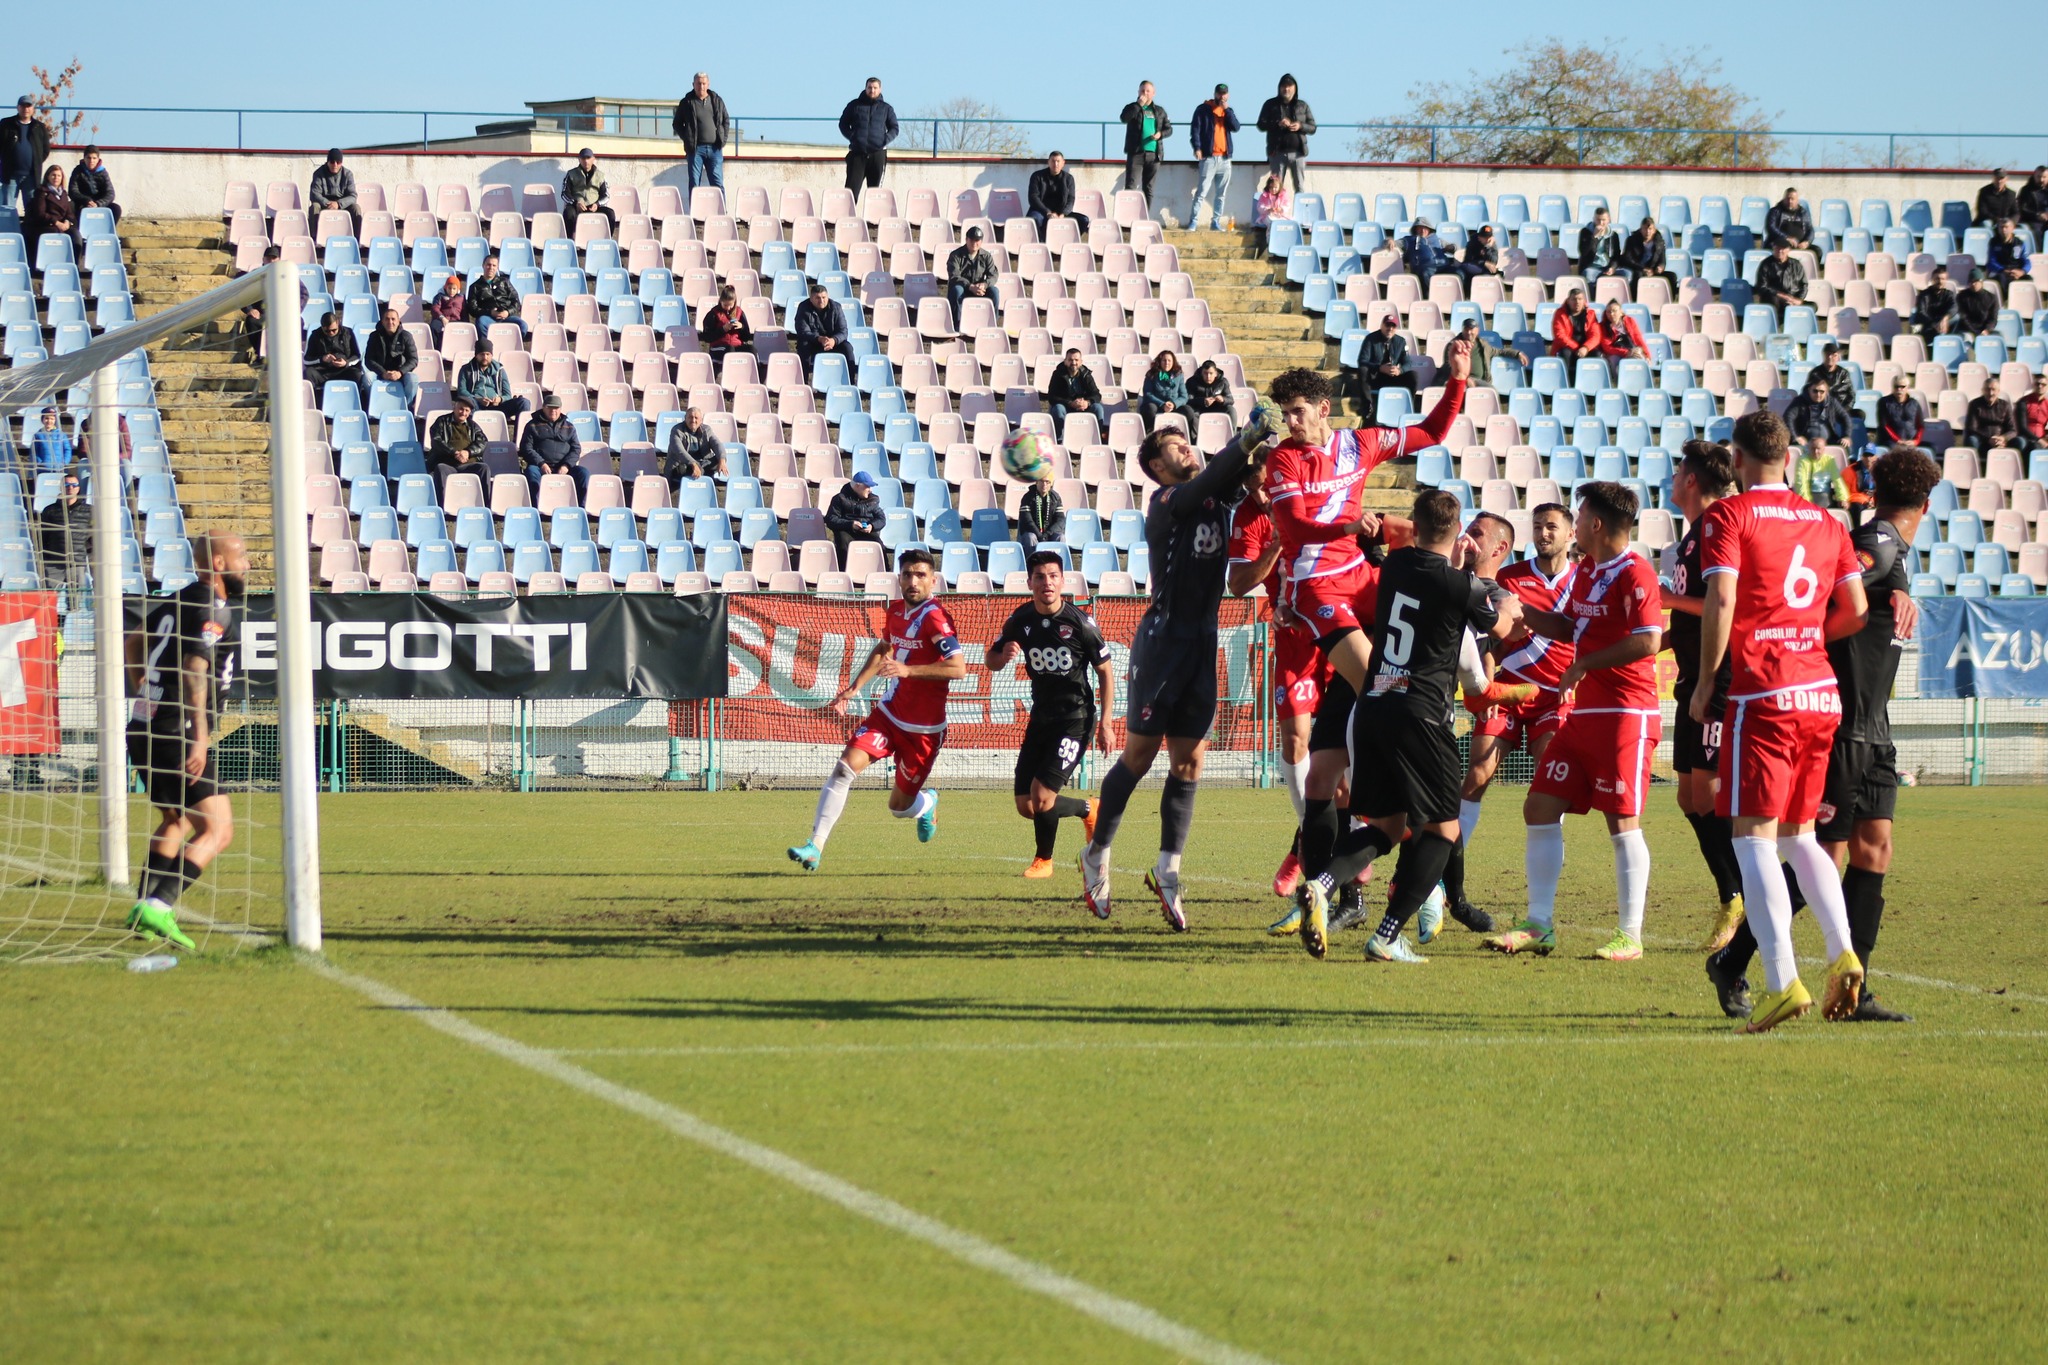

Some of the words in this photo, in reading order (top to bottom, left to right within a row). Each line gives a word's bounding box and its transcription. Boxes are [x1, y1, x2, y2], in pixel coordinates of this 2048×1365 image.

[1783, 544, 1819, 609] 6
[1383, 590, 1421, 666] 5
[940, 640, 951, 652] C
[1028, 646, 1073, 672] 888
[1294, 679, 1314, 701] 27
[872, 732, 889, 750] 10
[1701, 721, 1723, 748] 18
[1058, 737, 1080, 762] 33
[1545, 759, 1570, 782] 19
